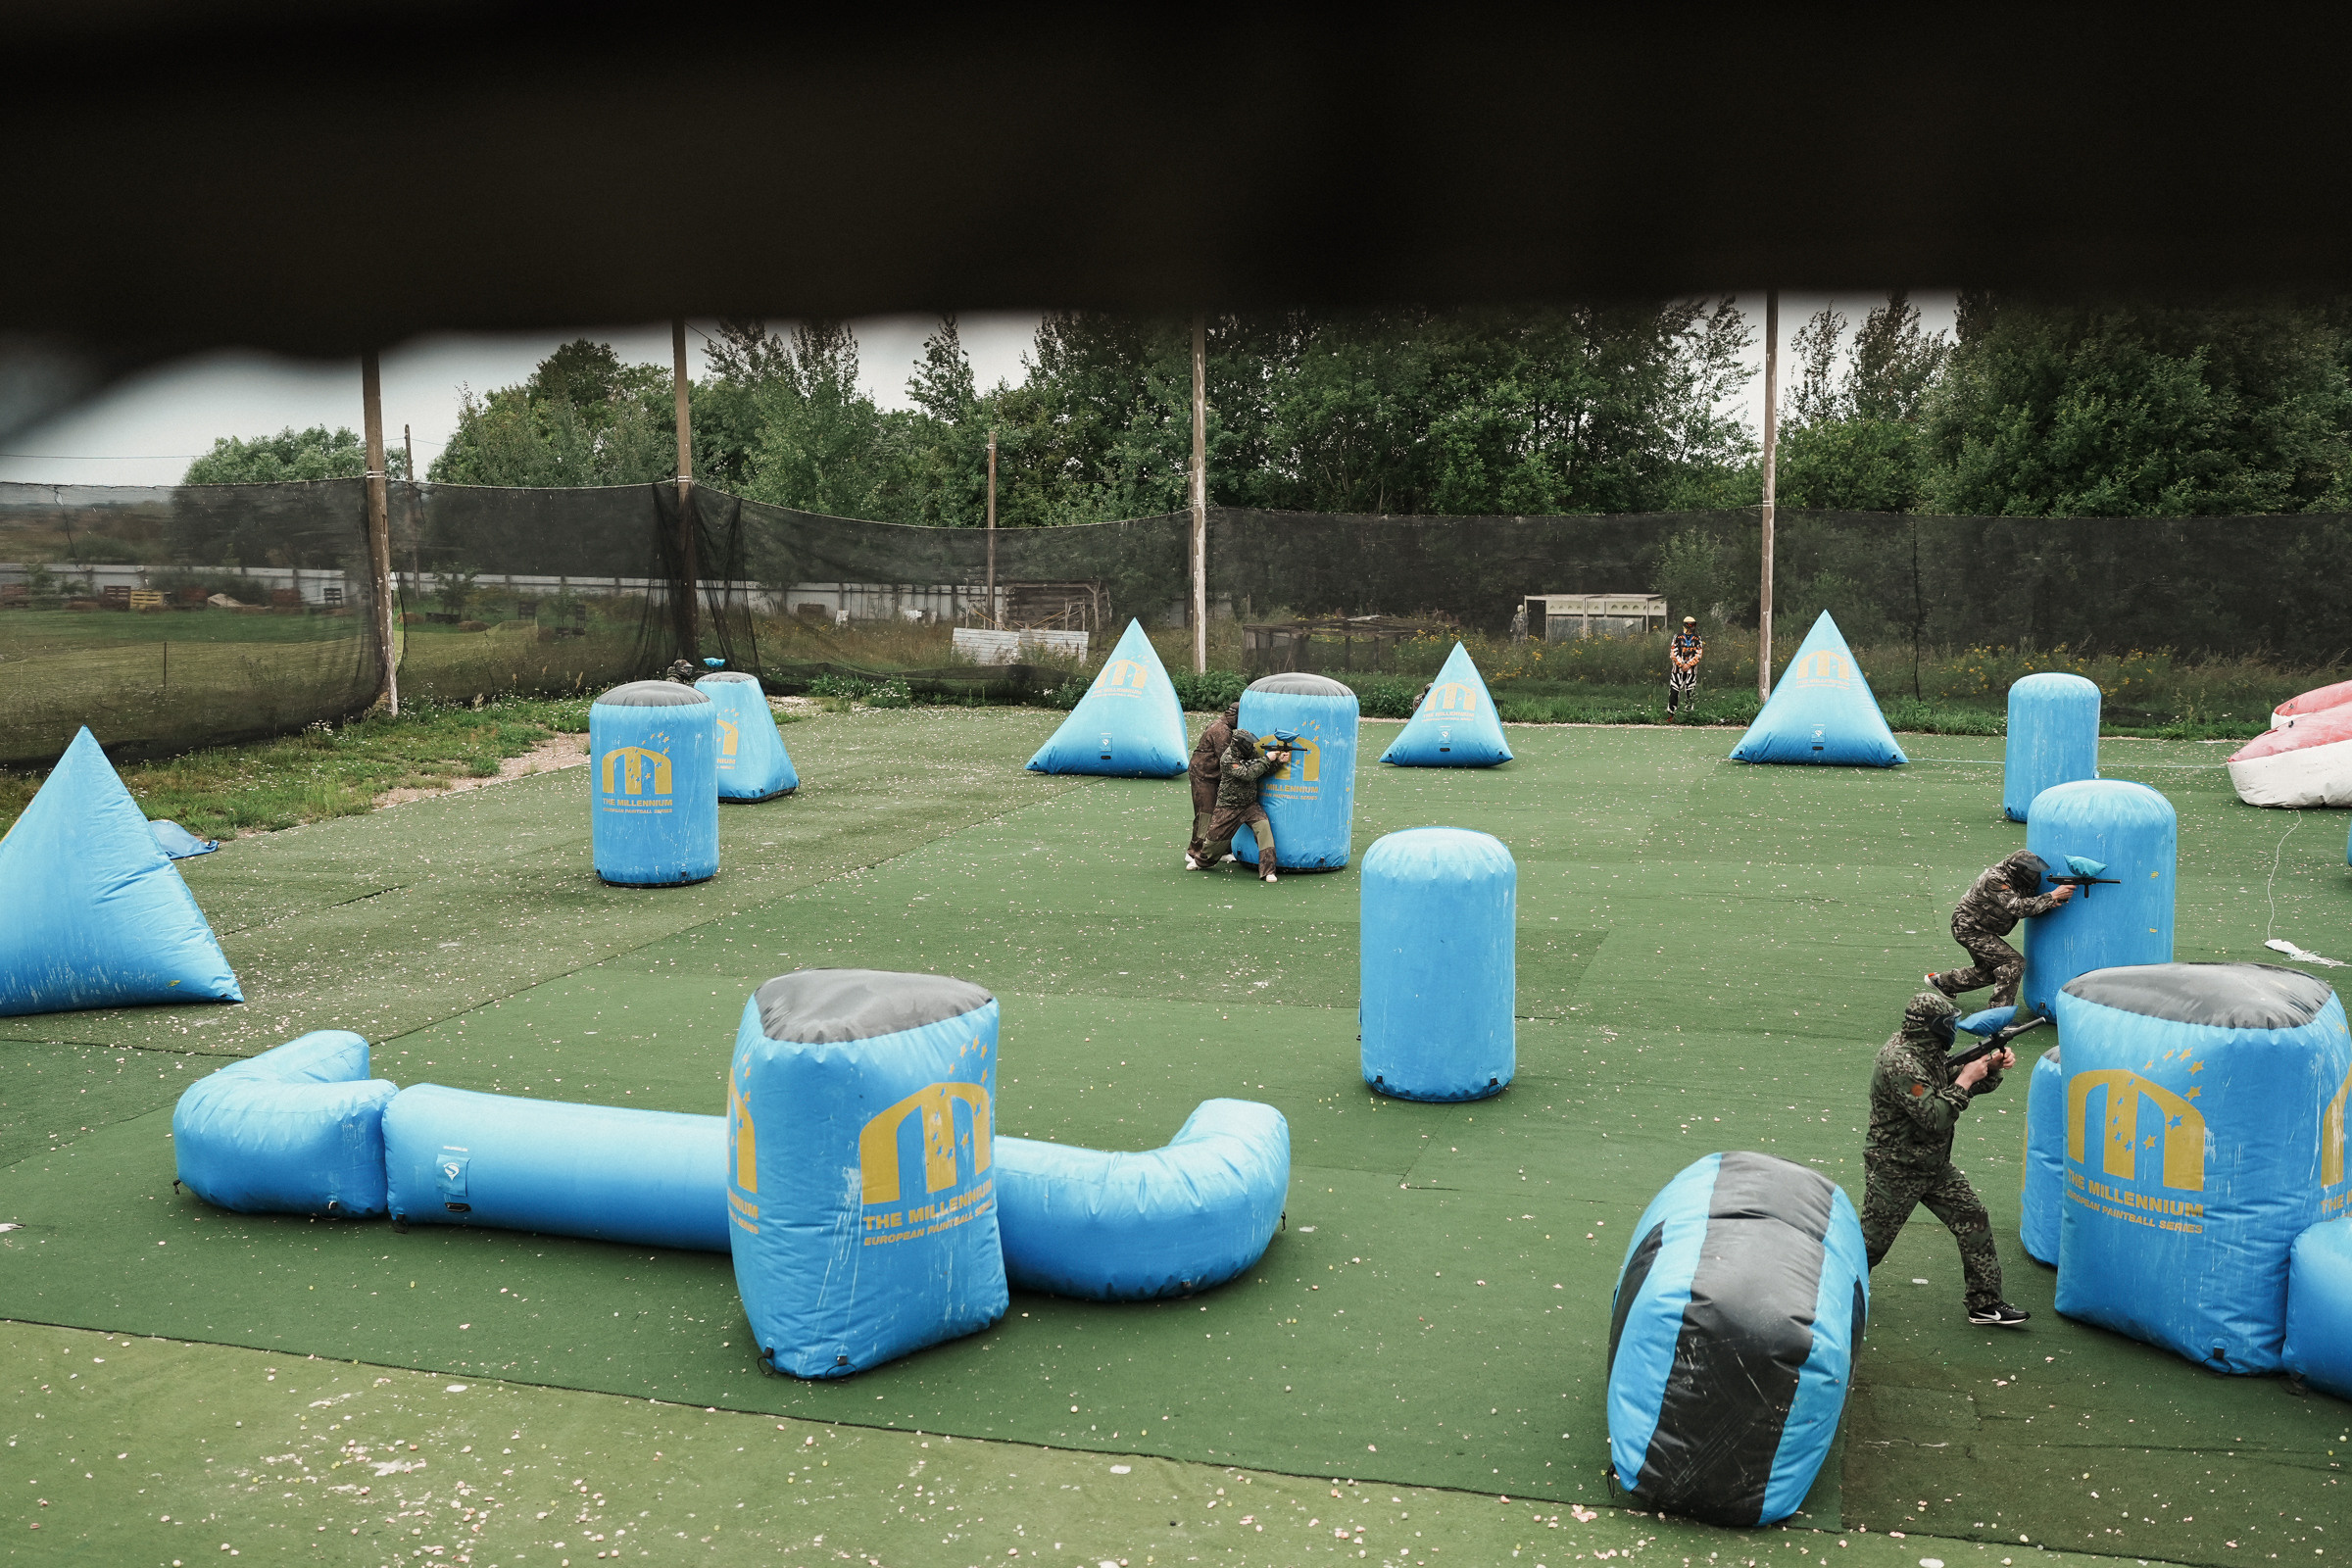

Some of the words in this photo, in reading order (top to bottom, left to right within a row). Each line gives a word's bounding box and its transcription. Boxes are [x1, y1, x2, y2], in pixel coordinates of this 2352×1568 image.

[603, 797, 615, 806] THE
[1266, 783, 1319, 794] MILLENNIUM
[862, 1211, 903, 1231] THE
[908, 1177, 992, 1224] MILLENNIUM
[2067, 1167, 2085, 1190] THE
[2088, 1179, 2204, 1217] MILLENNIUM
[2320, 1194, 2344, 1214] THE
[864, 1228, 925, 1246] EUROPEAN
[927, 1211, 974, 1235] PAINTBALL
[2102, 1205, 2156, 1228] PAINTBALL
[2159, 1219, 2203, 1234] SERIES
